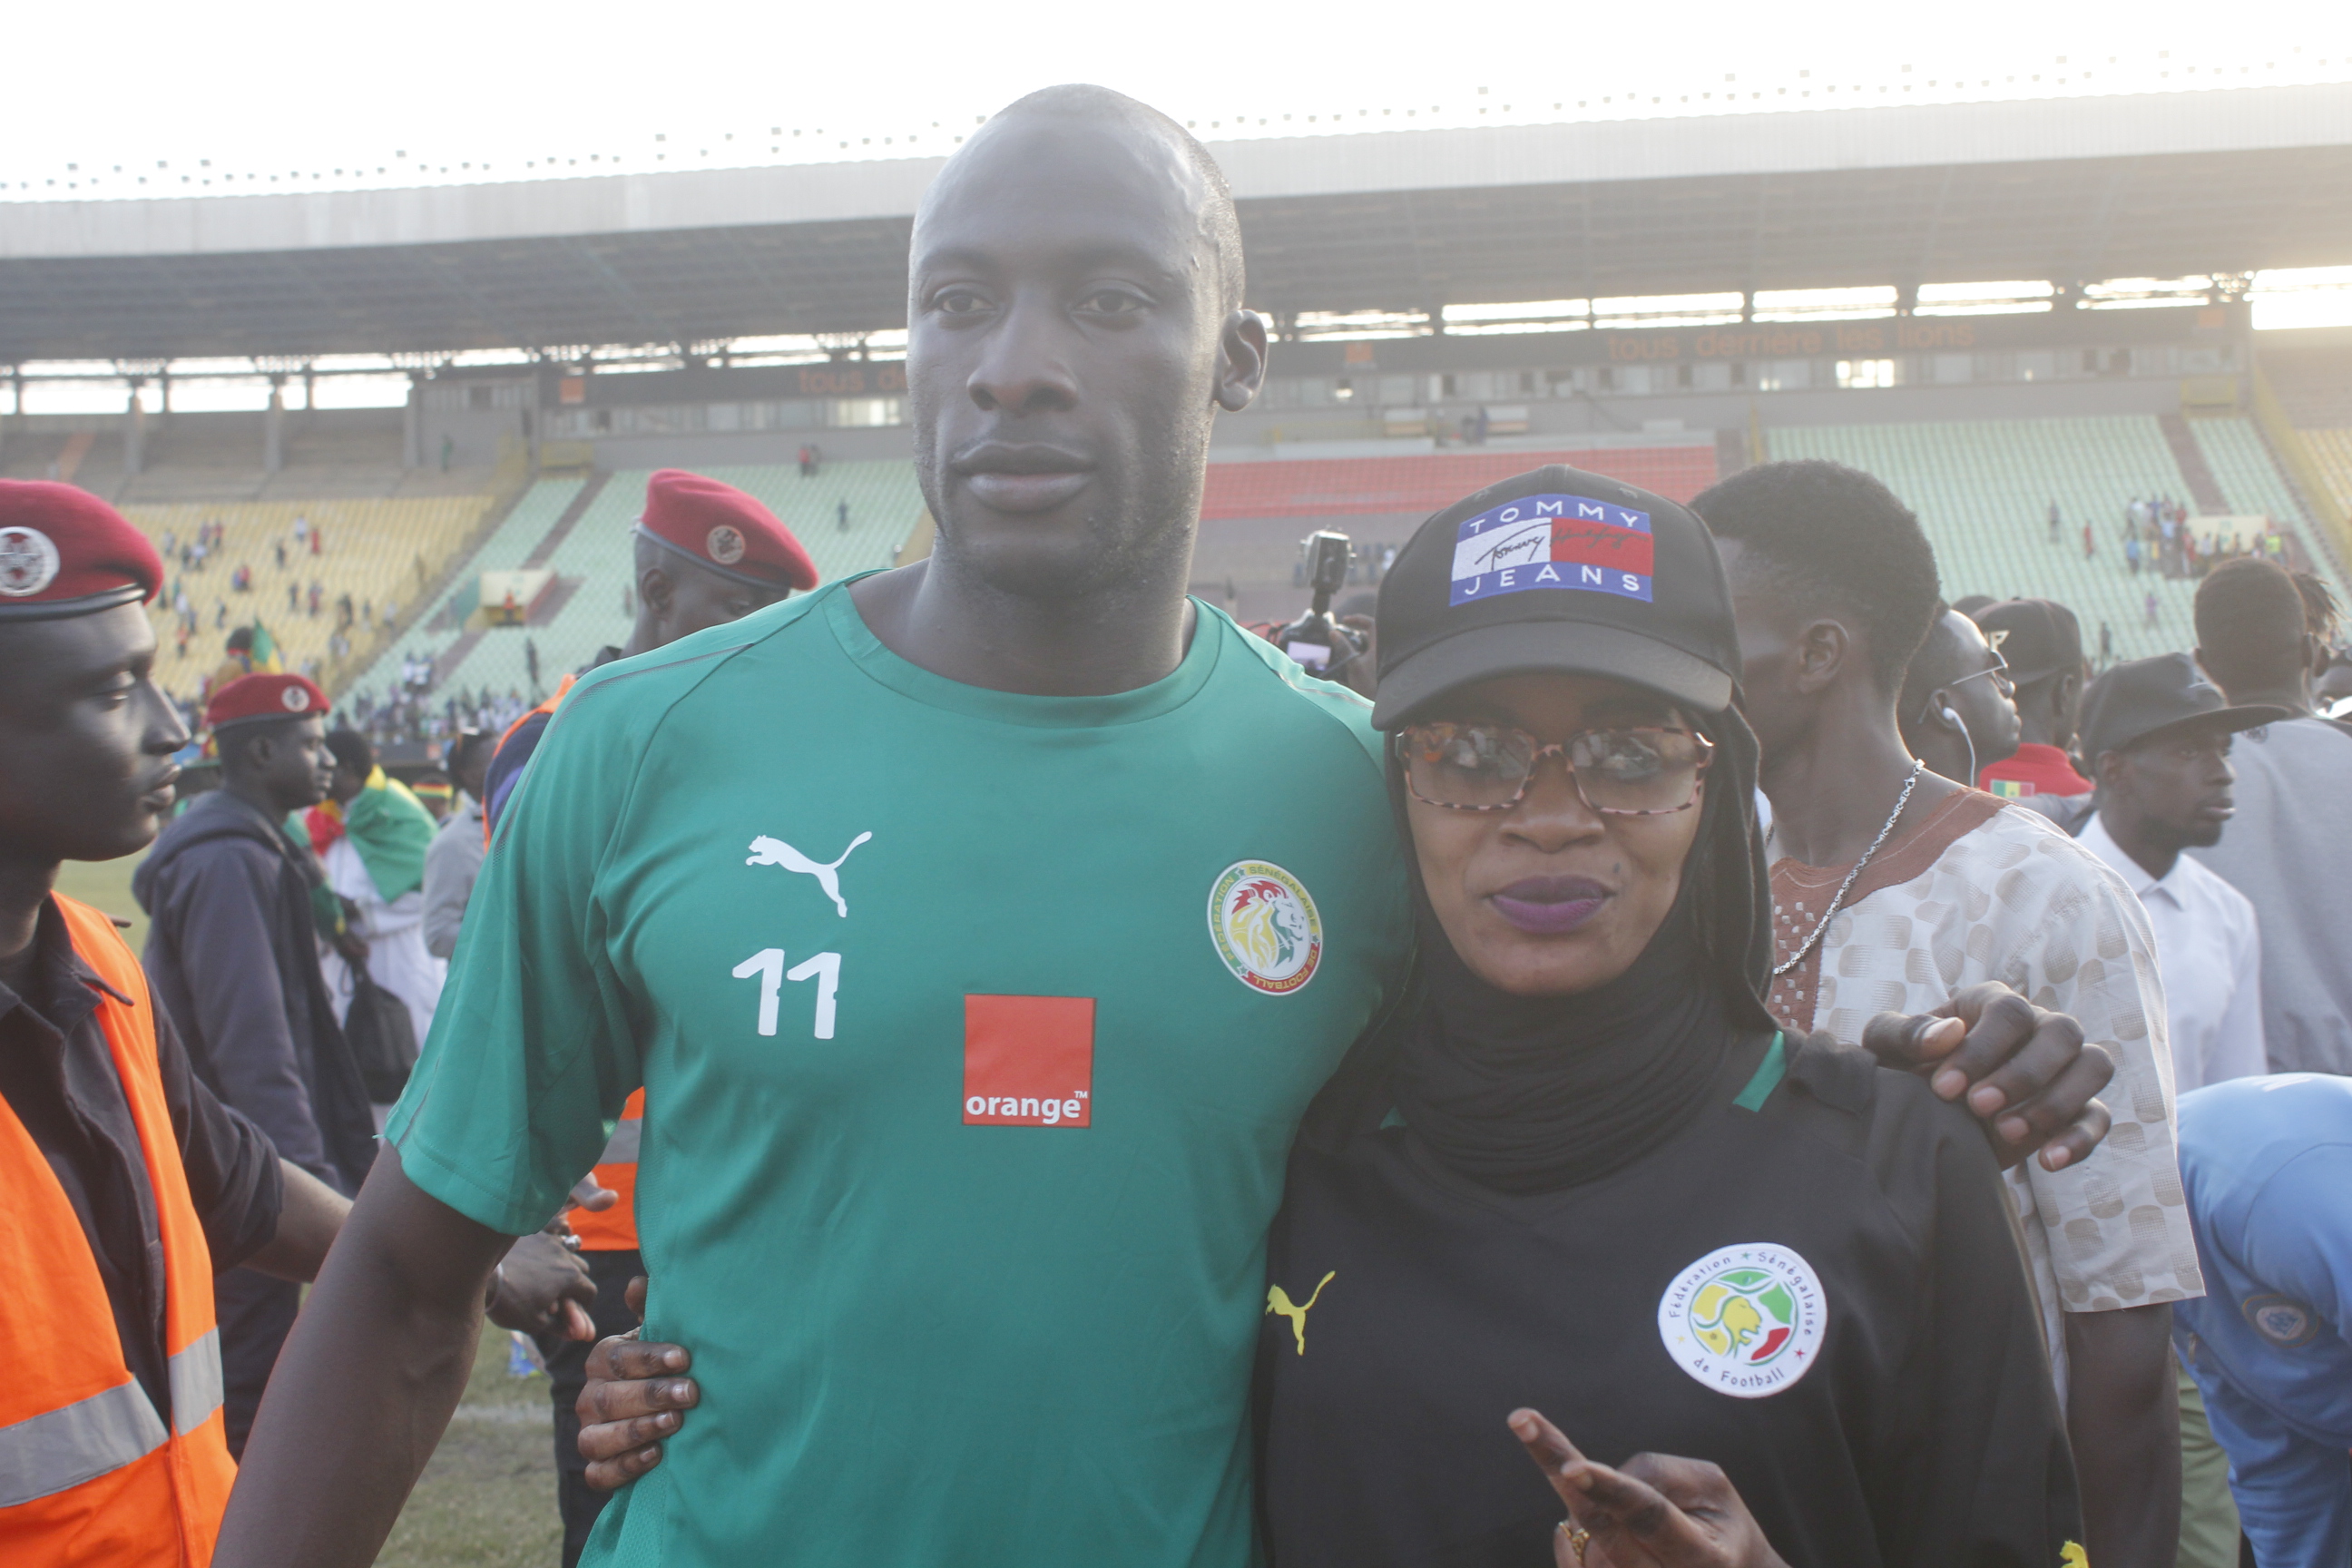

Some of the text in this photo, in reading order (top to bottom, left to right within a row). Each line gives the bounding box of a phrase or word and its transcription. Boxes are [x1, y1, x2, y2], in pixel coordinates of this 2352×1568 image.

[1608, 333, 1678, 360] tous
[1837, 323, 1885, 351] les
[1897, 320, 1976, 348] lions
[799, 368, 866, 393] tous
[1469, 500, 1639, 534] TOMMY
[1465, 564, 1640, 595] JEANS
[731, 947, 842, 1040] 11
[1253, 968, 1309, 990] FOOTBALL
[965, 1095, 1082, 1124] orange
[1669, 1251, 1814, 1336] Fédération Sénégalaise
[1693, 1357, 1785, 1387] de Football
